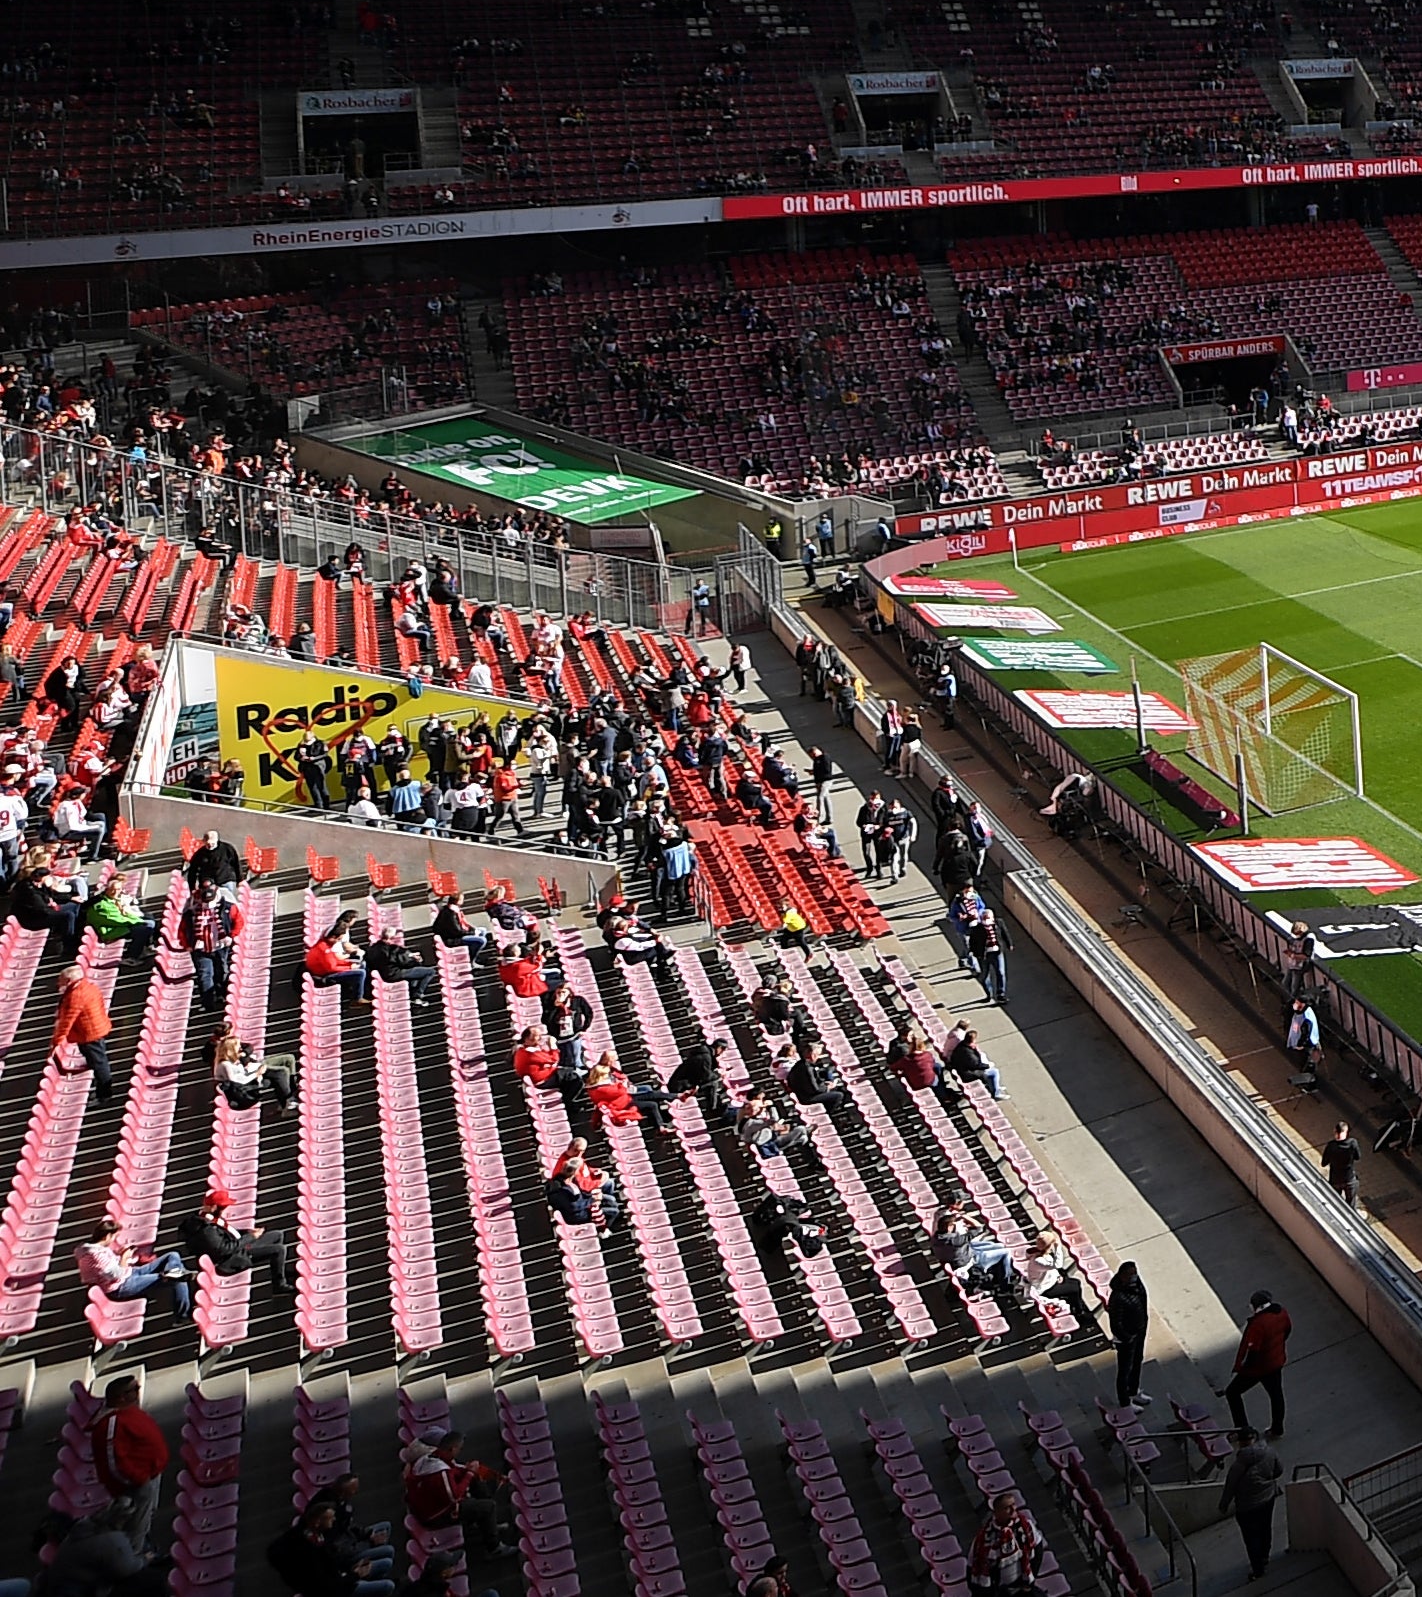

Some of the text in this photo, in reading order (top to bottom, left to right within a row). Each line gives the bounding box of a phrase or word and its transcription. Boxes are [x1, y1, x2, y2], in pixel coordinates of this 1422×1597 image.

[1295, 62, 1342, 75] Rosbacher
[866, 78, 922, 90] Rosbacher
[323, 96, 398, 110] Rosbacher
[1243, 159, 1422, 183] Oft hart, IMMER sportlich.
[783, 197, 808, 213] Oft
[814, 194, 855, 211] hart,
[861, 189, 923, 208] IMMER
[928, 184, 1008, 205] sportlich.
[253, 219, 464, 246] RheinEnergieSTADION
[1189, 341, 1274, 361] SPÜRBAR ANDERS.
[473, 431, 521, 449] on,
[441, 449, 557, 485] FC!
[1309, 453, 1366, 477] REWE
[1376, 449, 1409, 466] Dein
[513, 475, 638, 510] DEVK
[1128, 467, 1292, 505] REWE Dein Markt
[920, 494, 1103, 533] REWE Dein Markt
[1162, 504, 1190, 514] BUSINESS
[1162, 514, 1177, 522] CLUB
[237, 684, 398, 740] Radio
[460, 792, 466, 801] 4
